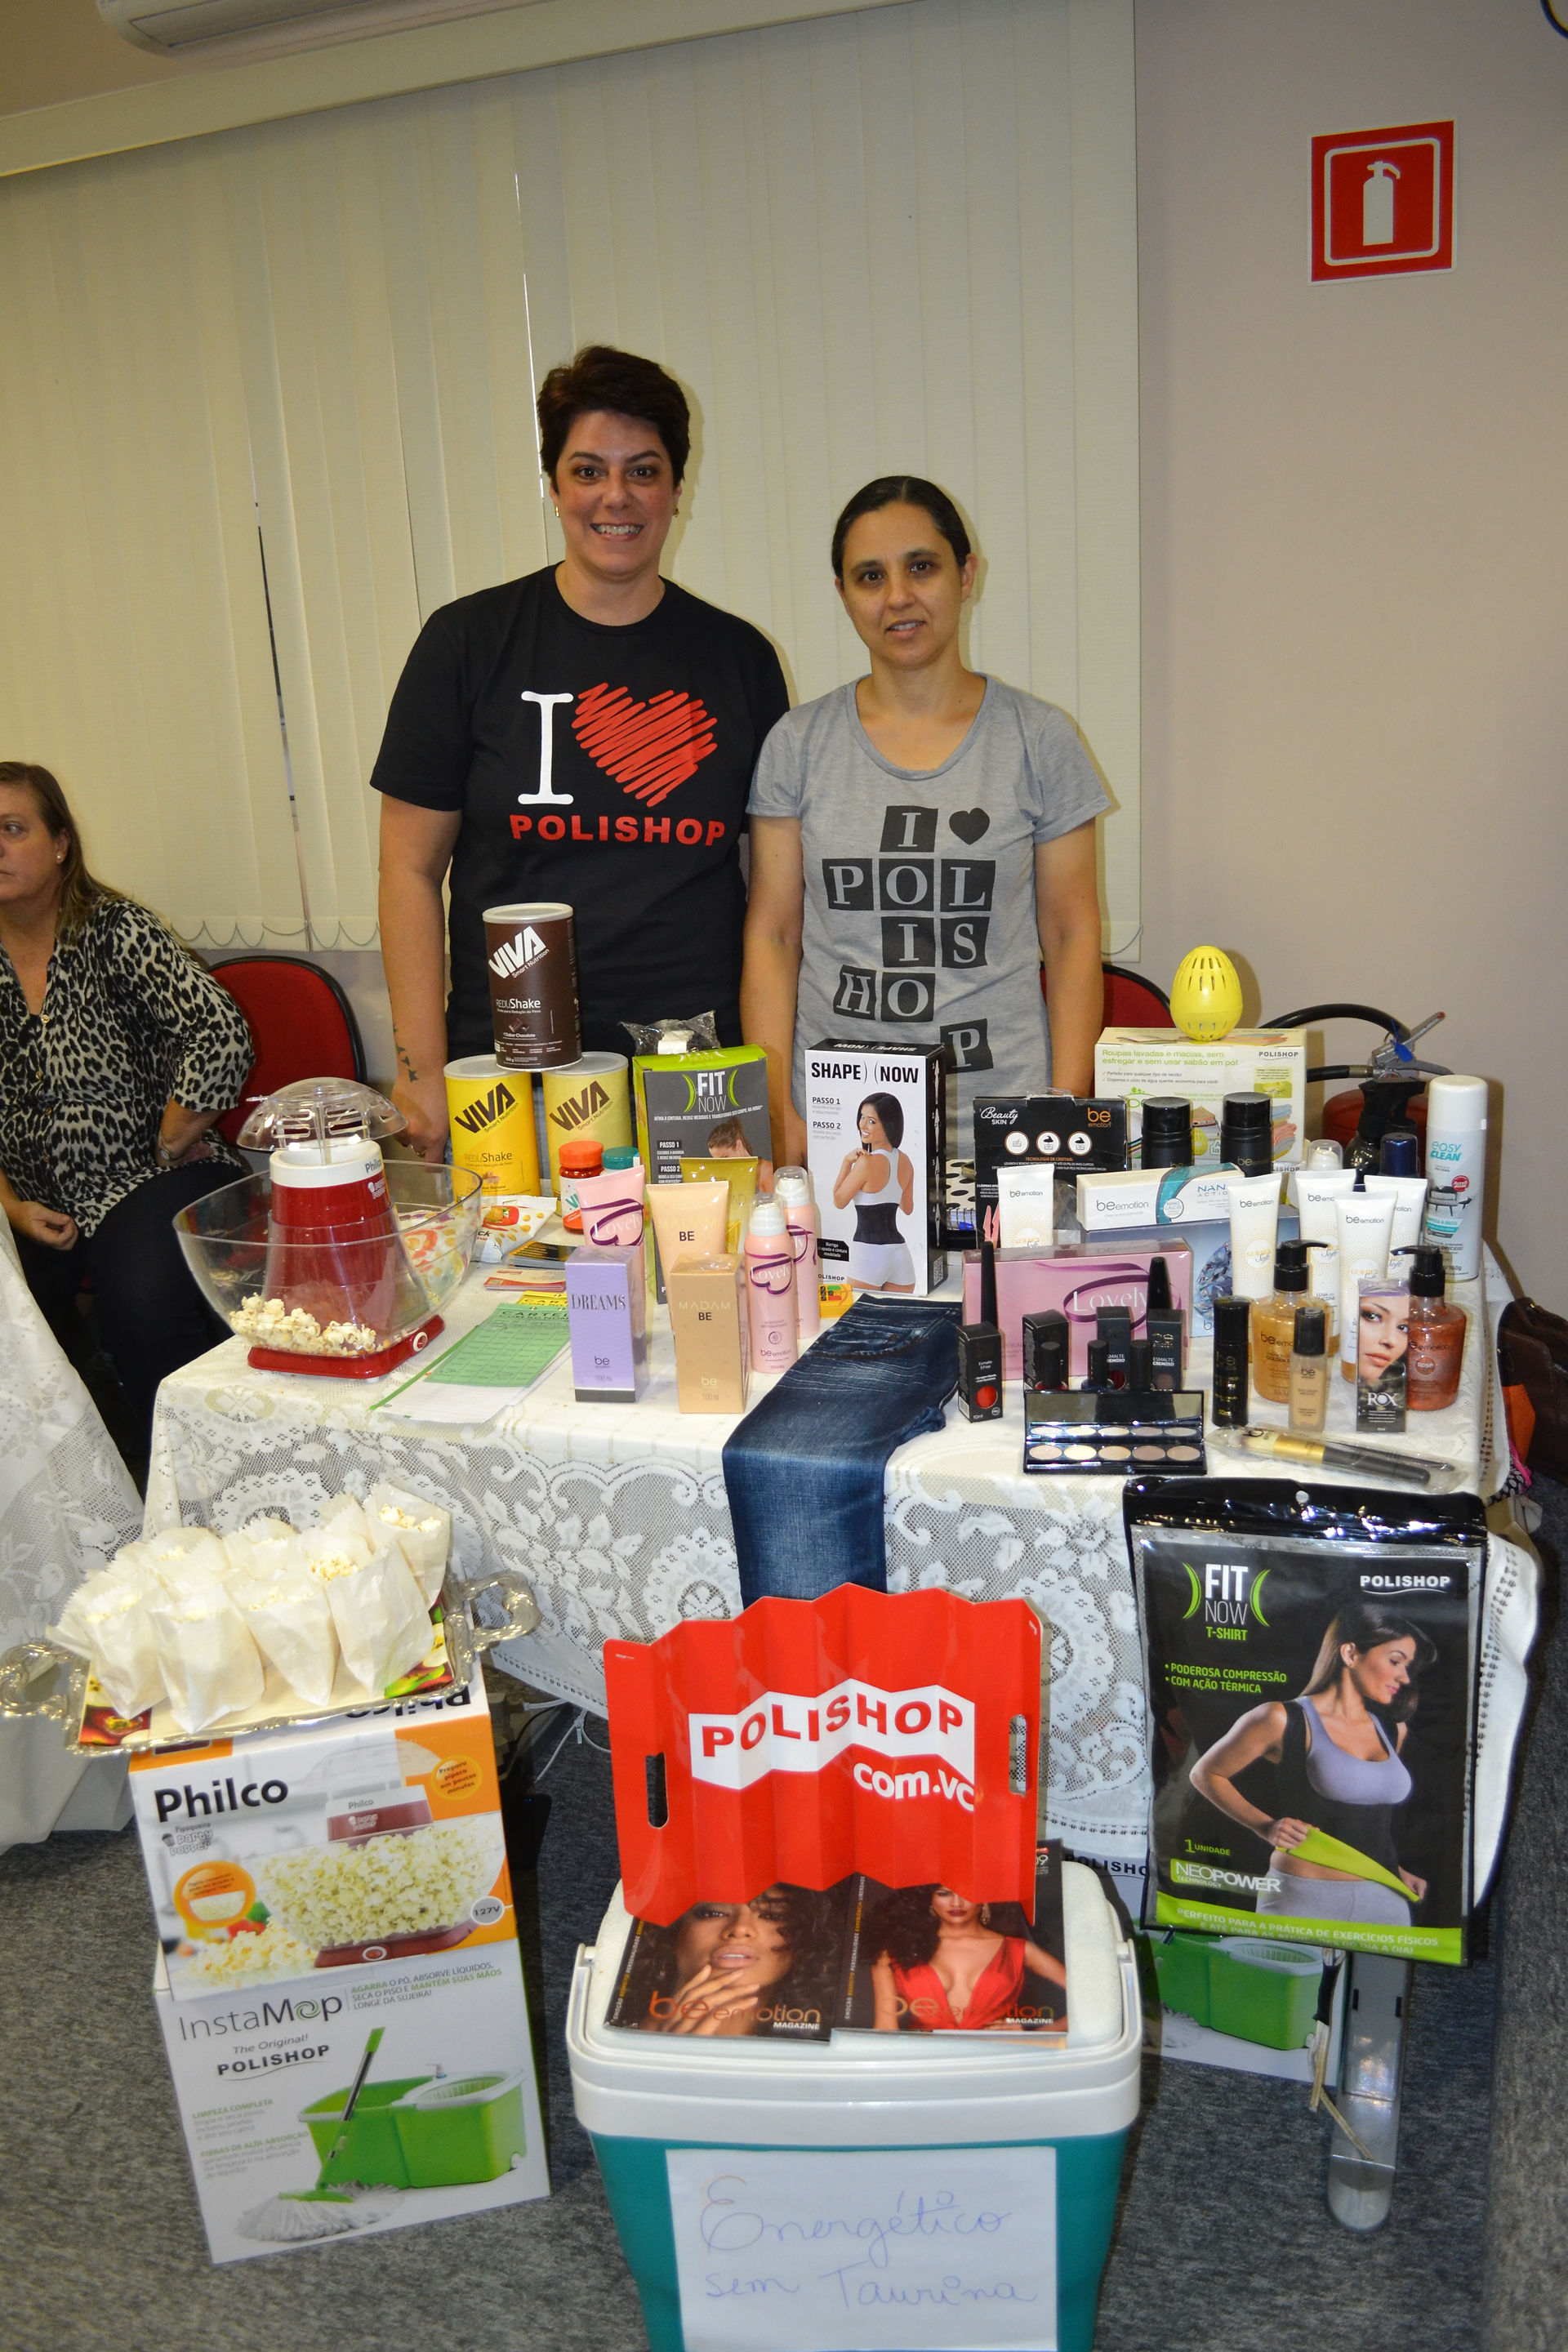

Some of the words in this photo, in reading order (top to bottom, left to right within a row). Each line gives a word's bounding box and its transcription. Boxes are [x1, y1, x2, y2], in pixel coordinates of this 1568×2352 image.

[518, 691, 574, 805] I
[510, 814, 725, 846] POLISHOP
[898, 812, 923, 848] I
[488, 925, 547, 979] VIVA
[512, 964, 528, 978] Smart
[528, 948, 550, 967] Nutrition
[697, 1071, 726, 1097] FIT
[811, 1062, 861, 1080] SHAPE
[880, 1066, 919, 1084] NOW
[454, 1082, 516, 1134] VIVA
[549, 1080, 611, 1131] VIVA
[698, 1095, 727, 1113] NOW
[1087, 1107, 1111, 1122] be
[484, 1120, 501, 1133] Smart
[499, 1102, 519, 1122] Nutrition
[577, 1119, 595, 1131] Smart
[594, 1101, 614, 1122] Nutrition
[980, 1107, 1019, 1125] Beauty
[1429, 1150, 1463, 1161] CLEAN
[1431, 1141, 1462, 1153] easy
[1197, 1184, 1226, 1192] NAN
[679, 1231, 695, 1241] BE
[817, 1273, 844, 1281] OLISHOP
[572, 1294, 626, 1311] DREAMS
[679, 1300, 731, 1311] MADAM
[698, 1312, 712, 1321] BE
[595, 1356, 610, 1365] be
[1301, 1366, 1316, 1377] be
[701, 1376, 718, 1387] be
[1367, 1392, 1398, 1406] ROX
[1205, 1563, 1249, 1601] FIT
[1360, 1575, 1451, 1588] POLISHOP
[1205, 1599, 1249, 1625] NOW
[1205, 1626, 1248, 1641] T-SHIRT
[1170, 1663, 1222, 1677] PODEROSA
[1223, 1666, 1287, 1682] COMPRESSÃO
[1170, 1676, 1192, 1687] COM
[1192, 1676, 1218, 1692] AÇÃO
[1219, 1677, 1262, 1694] TÉRMICA
[702, 1692, 963, 1757] POLISHOP
[853, 1762, 975, 1812] com.vc
[154, 1776, 289, 1823] Philco
[348, 1798, 374, 1809] Philco
[1184, 1838, 1196, 1854] 1
[1195, 1843, 1231, 1856] UNIDADE
[1064, 1852, 1147, 1877] POLISHO
[1176, 1861, 1281, 1892] NEOPOWER
[1177, 1876, 1222, 1888] TECHNOLOGY
[474, 1904, 501, 1917] 127V
[1177, 1908, 1226, 1923] PERFEITO
[1228, 1917, 1256, 1928] PARA
[1258, 1922, 1267, 1930] A
[1269, 1922, 1314, 1936] PRÁTICA
[1316, 1928, 1330, 1937] DE
[1333, 1931, 1395, 1943] EXERCÍCIOS
[1397, 1934, 1438, 1946] FÍSICOS
[351, 1980, 389, 1993] AGARRA
[413, 1969, 451, 1982] ABSORVE
[452, 1962, 494, 1976] LÍQUIDOS,
[352, 1993, 373, 2002] SECA
[383, 1987, 403, 1996] PISO
[410, 1977, 451, 1991] MANTÉM
[452, 1974, 475, 1984] SUAS
[476, 1967, 502, 1980] MÃOS
[353, 1999, 381, 2010] LONGE
[398, 1989, 432, 2002] SUJEIRA!
[649, 1989, 709, 2020] be
[713, 2004, 821, 2023] emotion
[178, 1992, 343, 2041] InstaMop
[773, 2021, 821, 2030] MAGAZINE
[232, 2043, 256, 2056] The
[257, 2033, 309, 2052] Original!
[216, 2044, 331, 2076] POLISHOP
[193, 2107, 229, 2119] LIMPEZA
[229, 2098, 274, 2112] COMPLETA
[201, 2146, 229, 2158] FIBRAS
[231, 2144, 243, 2152] DE
[243, 2140, 263, 2149] ALTA
[264, 2130, 310, 2145] ABSORÇÃO
[705, 2272, 800, 2299] sem
[817, 2260, 1037, 2310] Taurina
